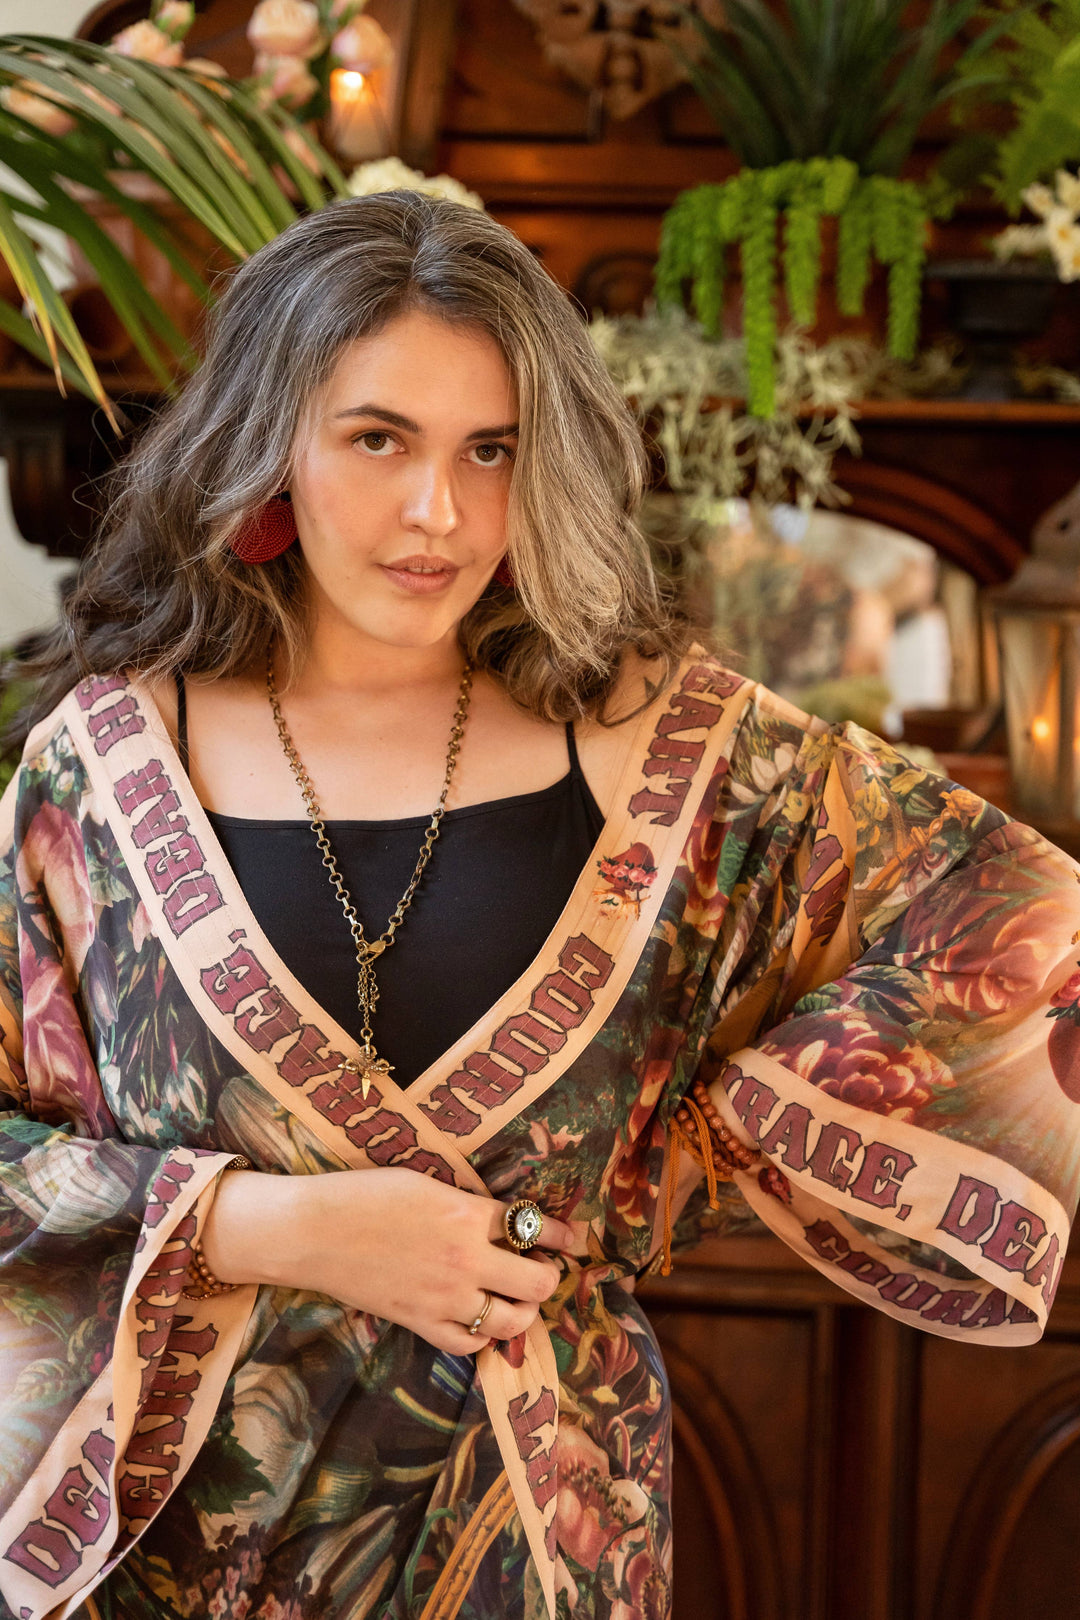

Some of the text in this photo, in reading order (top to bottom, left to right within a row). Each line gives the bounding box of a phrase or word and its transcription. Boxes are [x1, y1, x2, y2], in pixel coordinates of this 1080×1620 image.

[75, 674, 147, 757] HE
[627, 656, 746, 827] EART
[113, 758, 228, 940] DEAR
[416, 931, 616, 1138] COURA
[721, 1061, 1064, 1313] RAGE, DEA
[2, 1403, 116, 1590] DEA
[112, 1316, 219, 1545] EART
